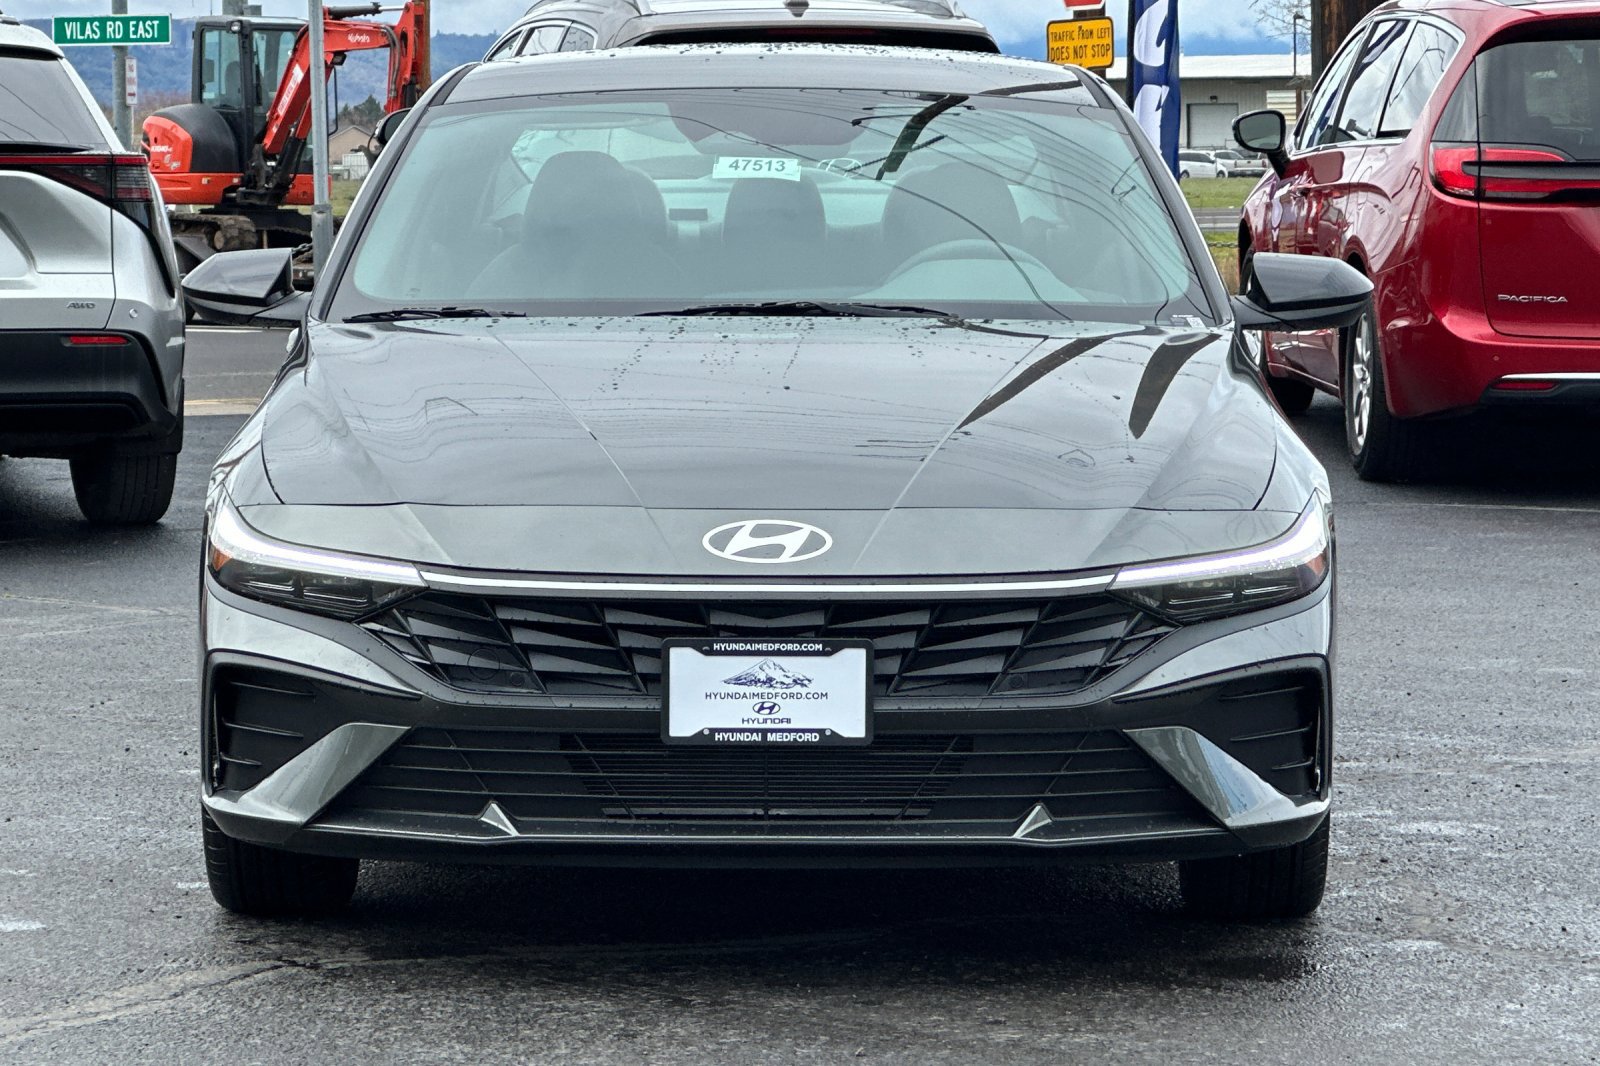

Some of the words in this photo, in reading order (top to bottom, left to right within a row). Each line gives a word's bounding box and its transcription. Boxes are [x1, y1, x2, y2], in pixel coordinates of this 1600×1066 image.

[64, 21, 100, 40] VILAS
[106, 20, 123, 39] RD
[129, 20, 159, 39] EAST
[1050, 30, 1075, 42] TRAFFIC
[1077, 25, 1094, 40] FROM
[1096, 27, 1111, 39] LEFT
[1050, 46, 1070, 62] DOES
[1073, 44, 1088, 60] NOT
[1091, 43, 1111, 58] STOP
[728, 159, 786, 172] 47513
[1497, 294, 1569, 303] PACIFICA
[713, 643, 823, 651] HYUNDAIMEDFORD.COM
[705, 692, 829, 700] HYUNDAIMEDFORD.COM
[741, 717, 792, 725] HYUNDAI
[714, 732, 762, 742] HYUNDAI
[766, 733, 820, 742] MEDFORD
